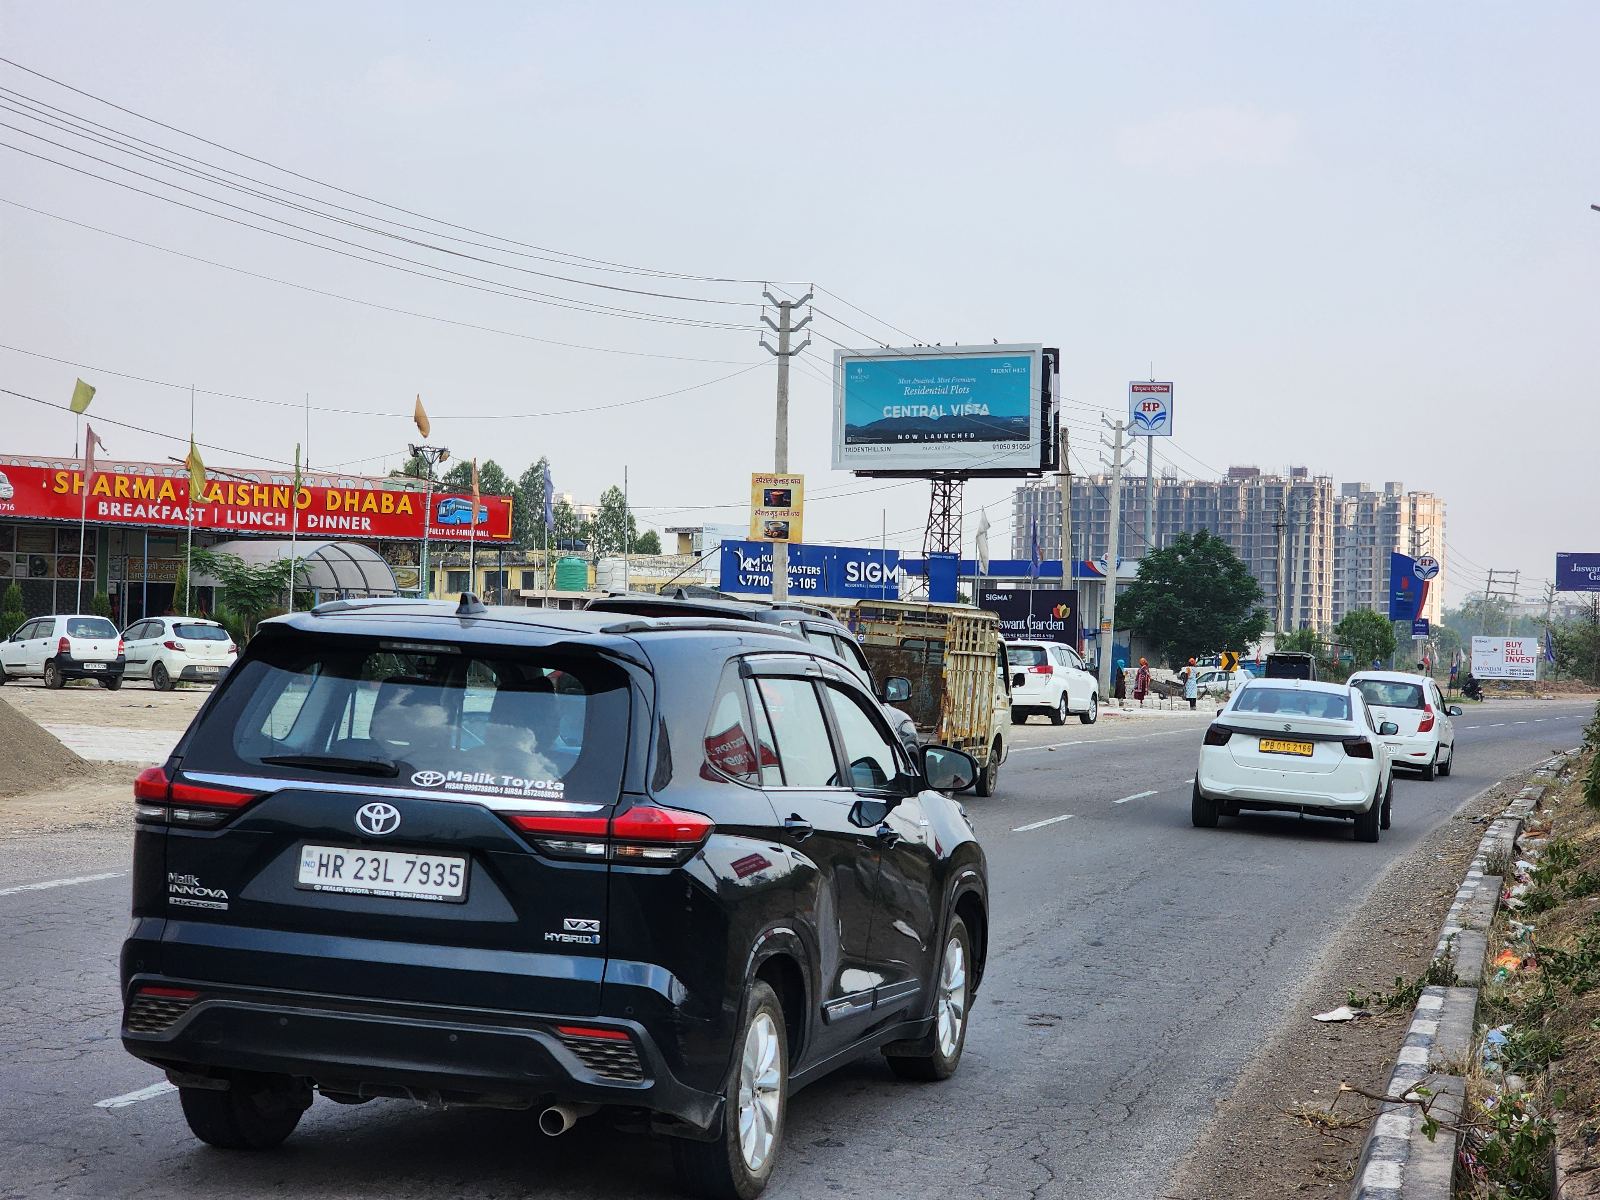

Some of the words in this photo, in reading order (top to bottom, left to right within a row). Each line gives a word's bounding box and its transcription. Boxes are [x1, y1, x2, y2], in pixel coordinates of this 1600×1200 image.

[904, 385, 949, 395] Residential
[950, 385, 970, 394] Plots
[883, 404, 947, 418] CENTRAL
[951, 403, 990, 416] VISTA
[1142, 402, 1160, 412] HP
[924, 432, 975, 440] LAUNCHED
[53, 471, 177, 502] SHARMA
[202, 481, 312, 510] AISHNO
[326, 489, 413, 515] DHABA
[98, 502, 206, 522] BREAKFAST
[226, 509, 286, 527] LUNCH
[307, 514, 372, 531] DINNER
[746, 574, 817, 590] 7710-5-105
[985, 593, 1008, 601] SIGMA
[1026, 613, 1065, 631] Garden
[1505, 656, 1535, 664] INVEST
[1265, 741, 1275, 749] PB
[446, 771, 496, 785] Malik
[501, 775, 565, 791] Toyota
[445, 782, 464, 790] HISAR
[504, 786, 523, 796] SIRSA
[317, 853, 345, 879] HR
[353, 856, 394, 883] 23L
[403, 860, 461, 888] 7935
[168, 872, 200, 887] Malik
[169, 884, 229, 899] INNOVA
[344, 886, 369, 895] TOYOTA
[565, 919, 598, 931] VX
